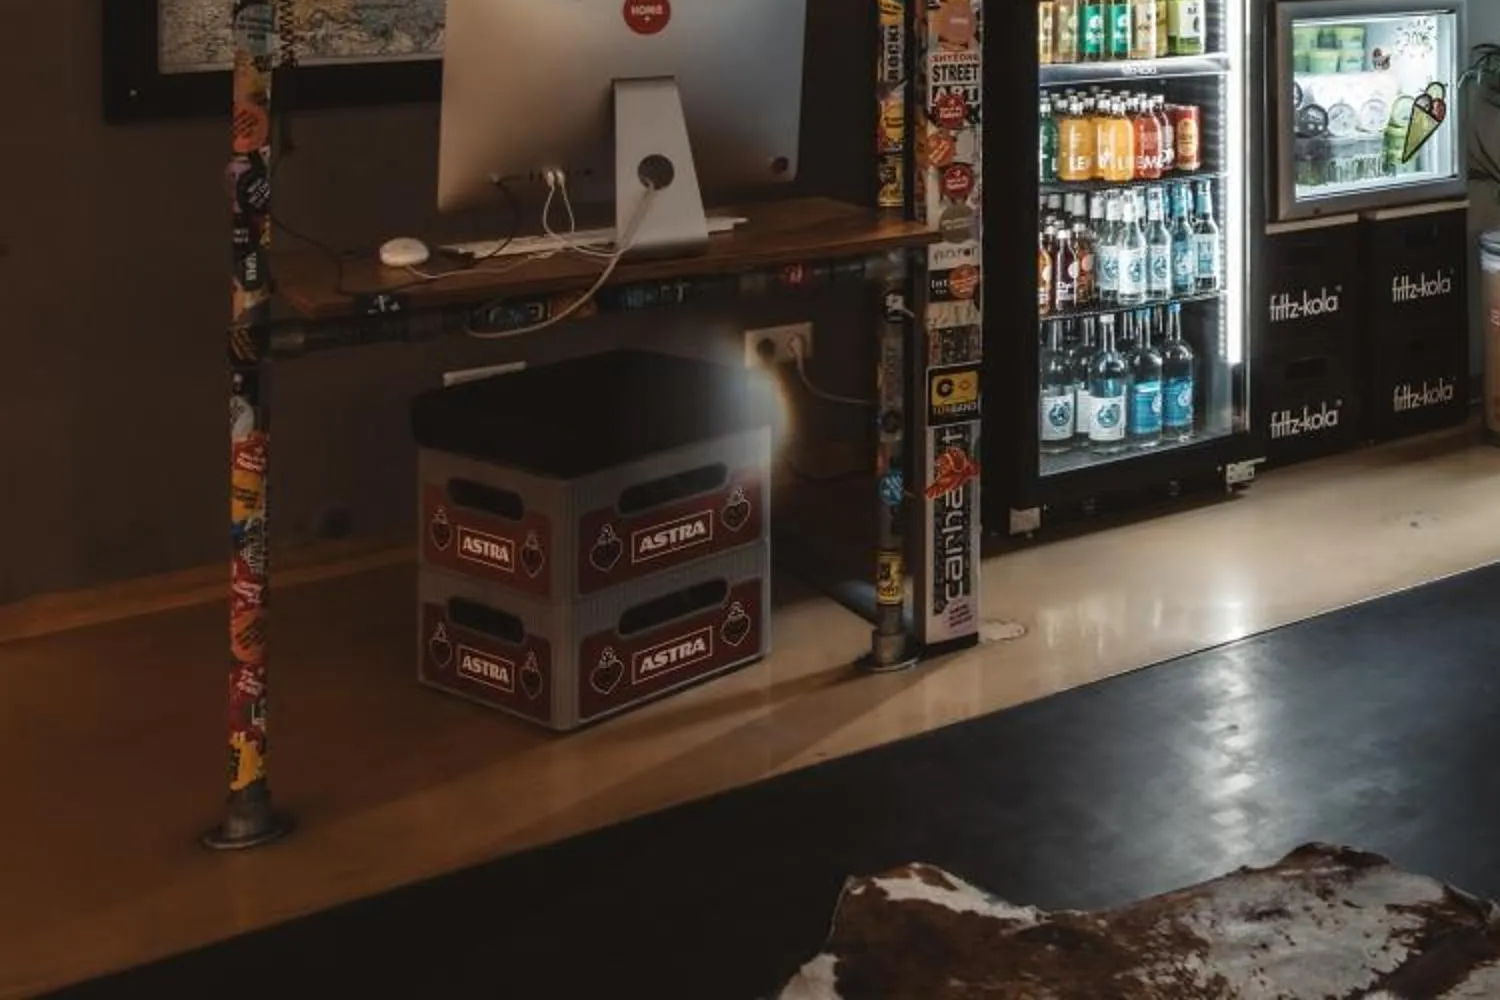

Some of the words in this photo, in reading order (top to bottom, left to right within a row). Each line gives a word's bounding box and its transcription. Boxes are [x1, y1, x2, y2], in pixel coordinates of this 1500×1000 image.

[931, 64, 979, 82] STREET
[1392, 270, 1451, 302] fritz-kola
[1269, 288, 1338, 321] fritz-kola
[1393, 378, 1453, 411] fritz-kola
[1270, 403, 1338, 438] fritz-kola
[944, 428, 963, 602] carhat
[462, 537, 509, 562] ASTRA
[639, 520, 706, 553] ASTRA
[462, 656, 509, 683] ASTRA
[640, 638, 706, 673] ASTRA
